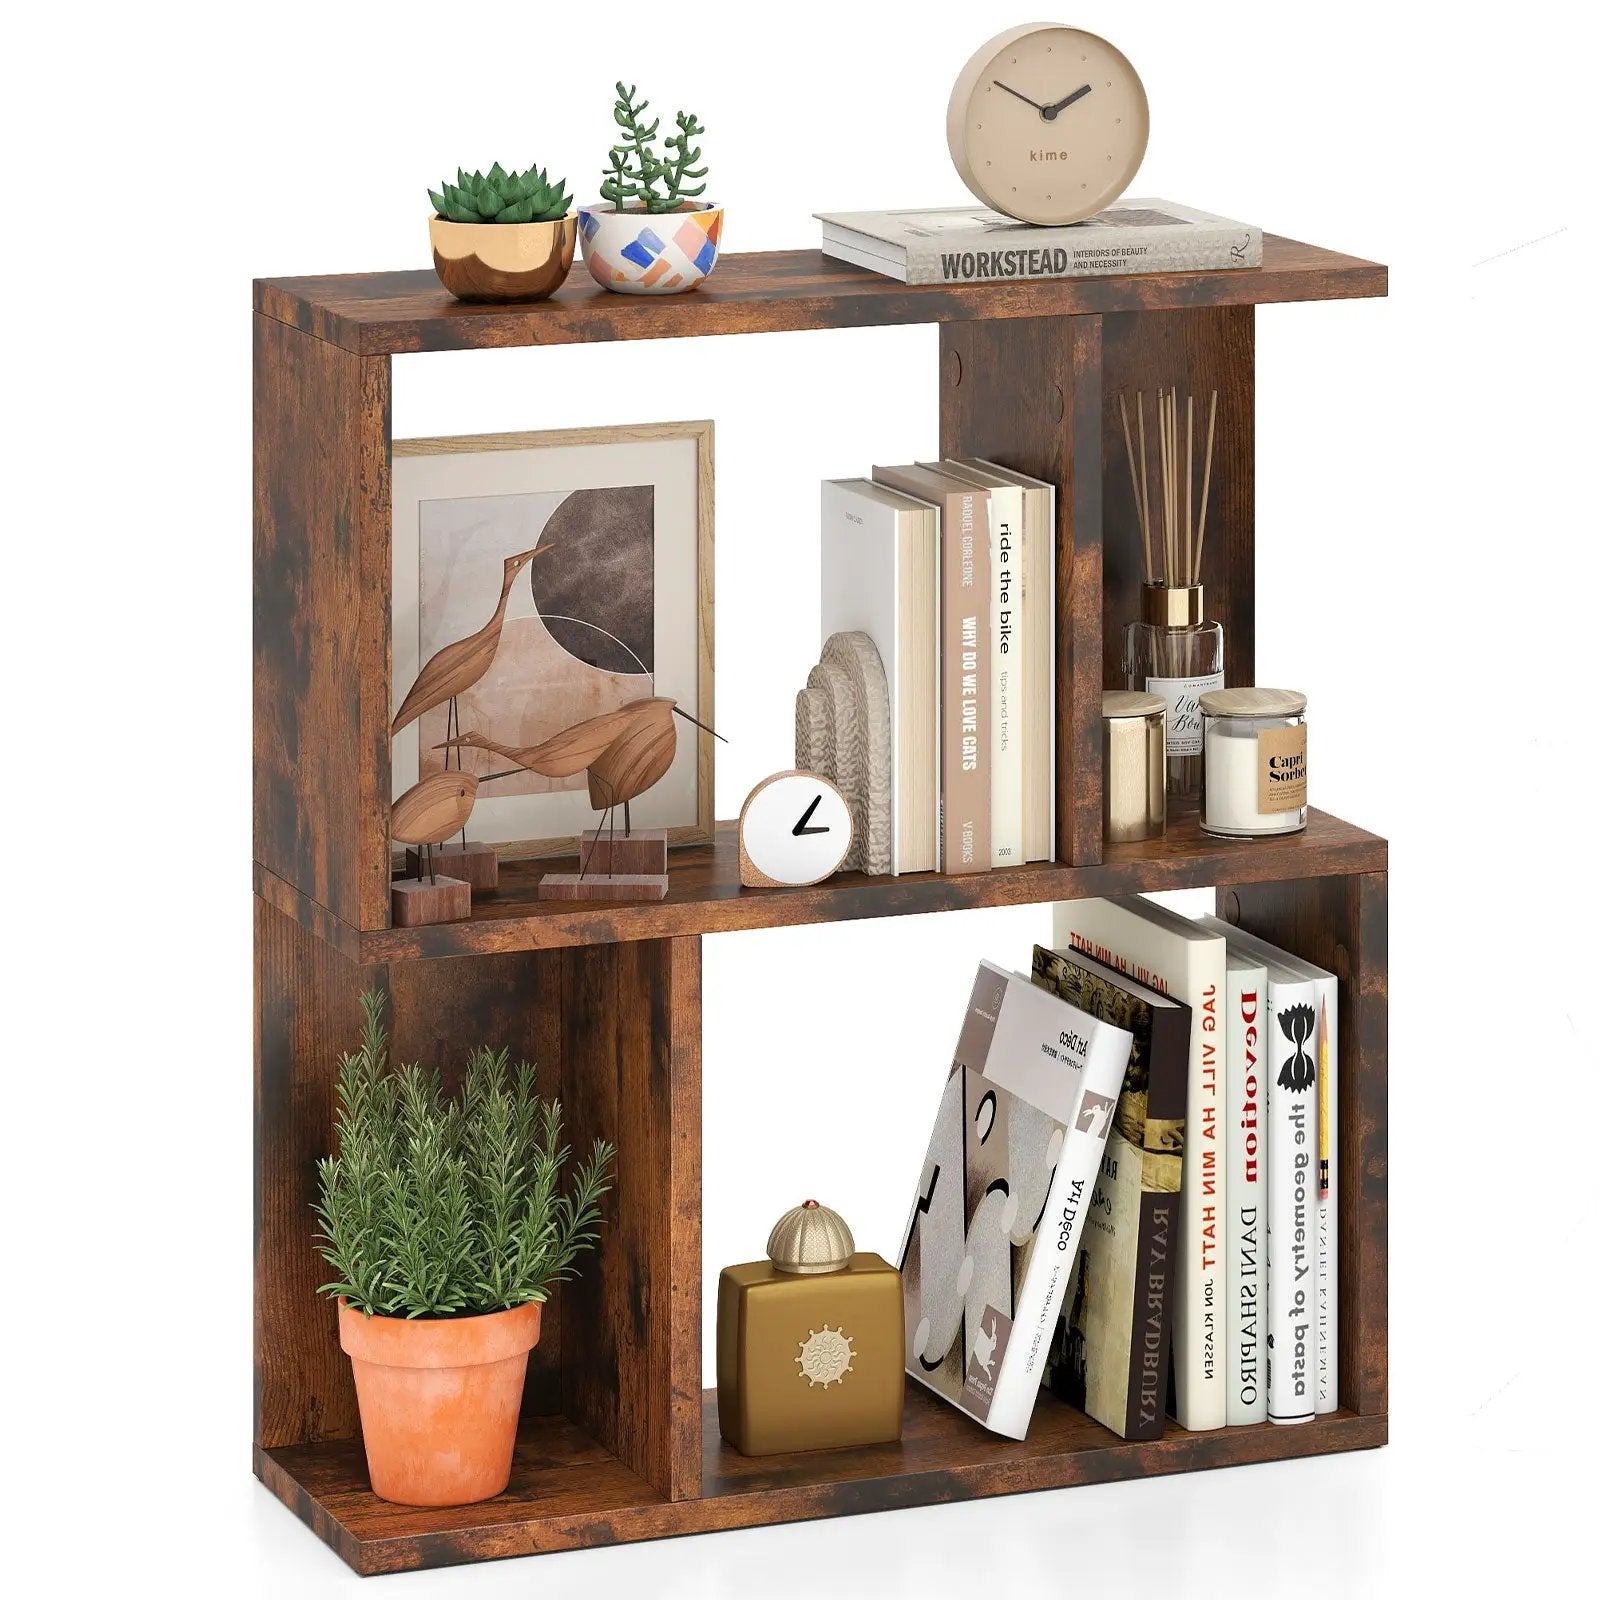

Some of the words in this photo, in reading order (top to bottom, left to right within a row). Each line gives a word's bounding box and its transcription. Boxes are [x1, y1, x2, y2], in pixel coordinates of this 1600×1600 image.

[1030, 149, 1068, 161] kime
[941, 248, 1067, 279] WORKSTEAD
[1073, 249, 1110, 258] INTERIORS
[1112, 248, 1121, 257] OF
[1121, 247, 1148, 256] BEAUTY
[1073, 261, 1089, 269] AND
[1090, 259, 1127, 268] NECESSITY
[1000, 523, 1011, 563] ride
[1000, 570, 1011, 604] the
[963, 616, 977, 648] WHY
[1000, 612, 1012, 654] bike
[963, 652, 977, 669] DO
[963, 672, 977, 695] WE
[1000, 671, 1009, 692] tips
[963, 699, 977, 733] LOVE
[1000, 695, 1008, 719] and
[1000, 722, 1009, 752] tricks
[963, 736, 977, 771] CATS
[1269, 751, 1303, 769] Capri
